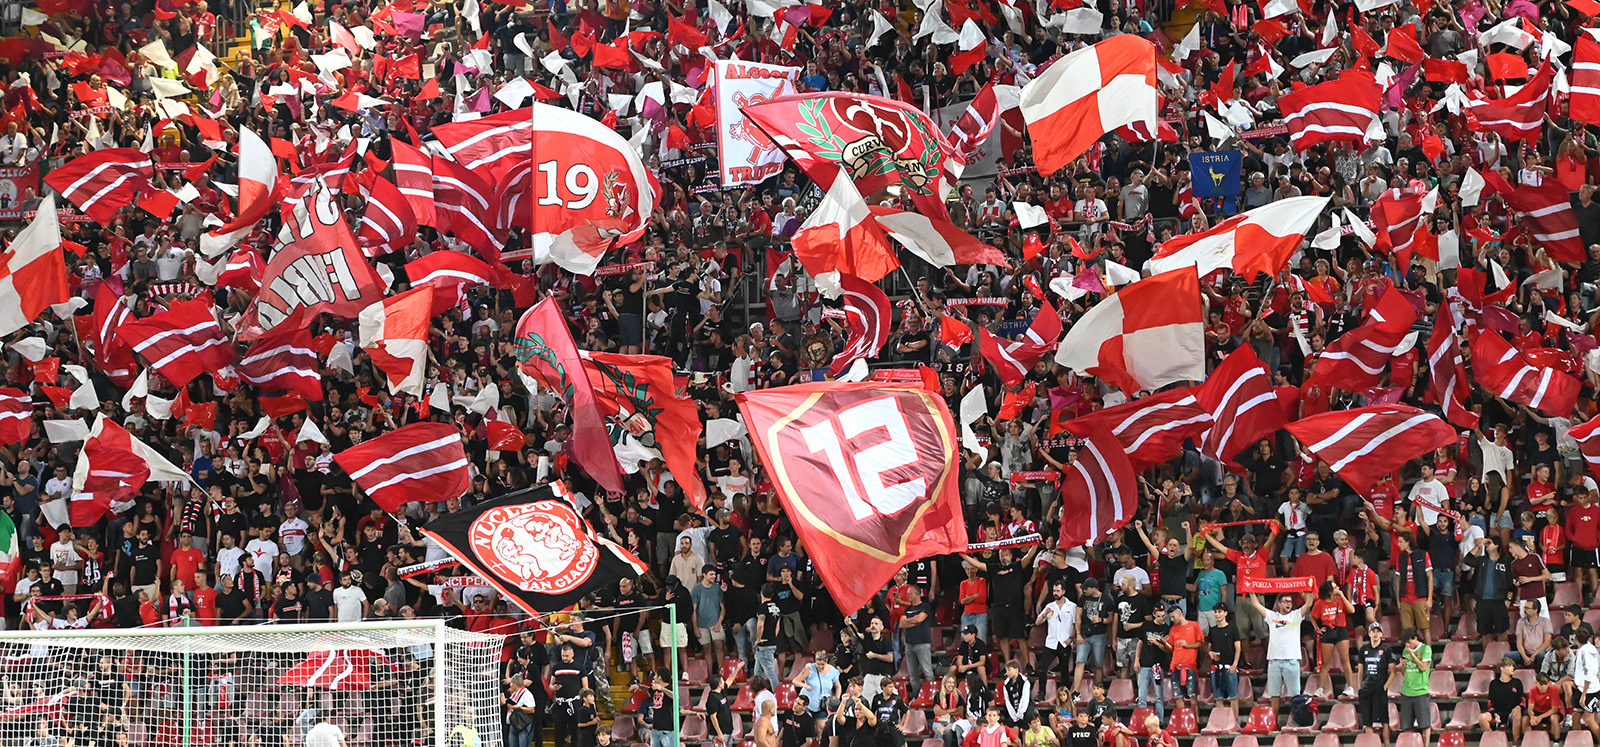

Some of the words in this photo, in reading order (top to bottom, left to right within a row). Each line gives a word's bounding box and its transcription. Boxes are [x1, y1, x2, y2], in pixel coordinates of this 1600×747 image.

[852, 139, 881, 157] CURV
[1202, 155, 1230, 163] ISTRIA
[538, 160, 600, 210] 19
[1000, 321, 1028, 329] STRIA
[799, 395, 927, 521] 12
[475, 502, 554, 550] NUCLEO
[520, 581, 552, 590] SAN
